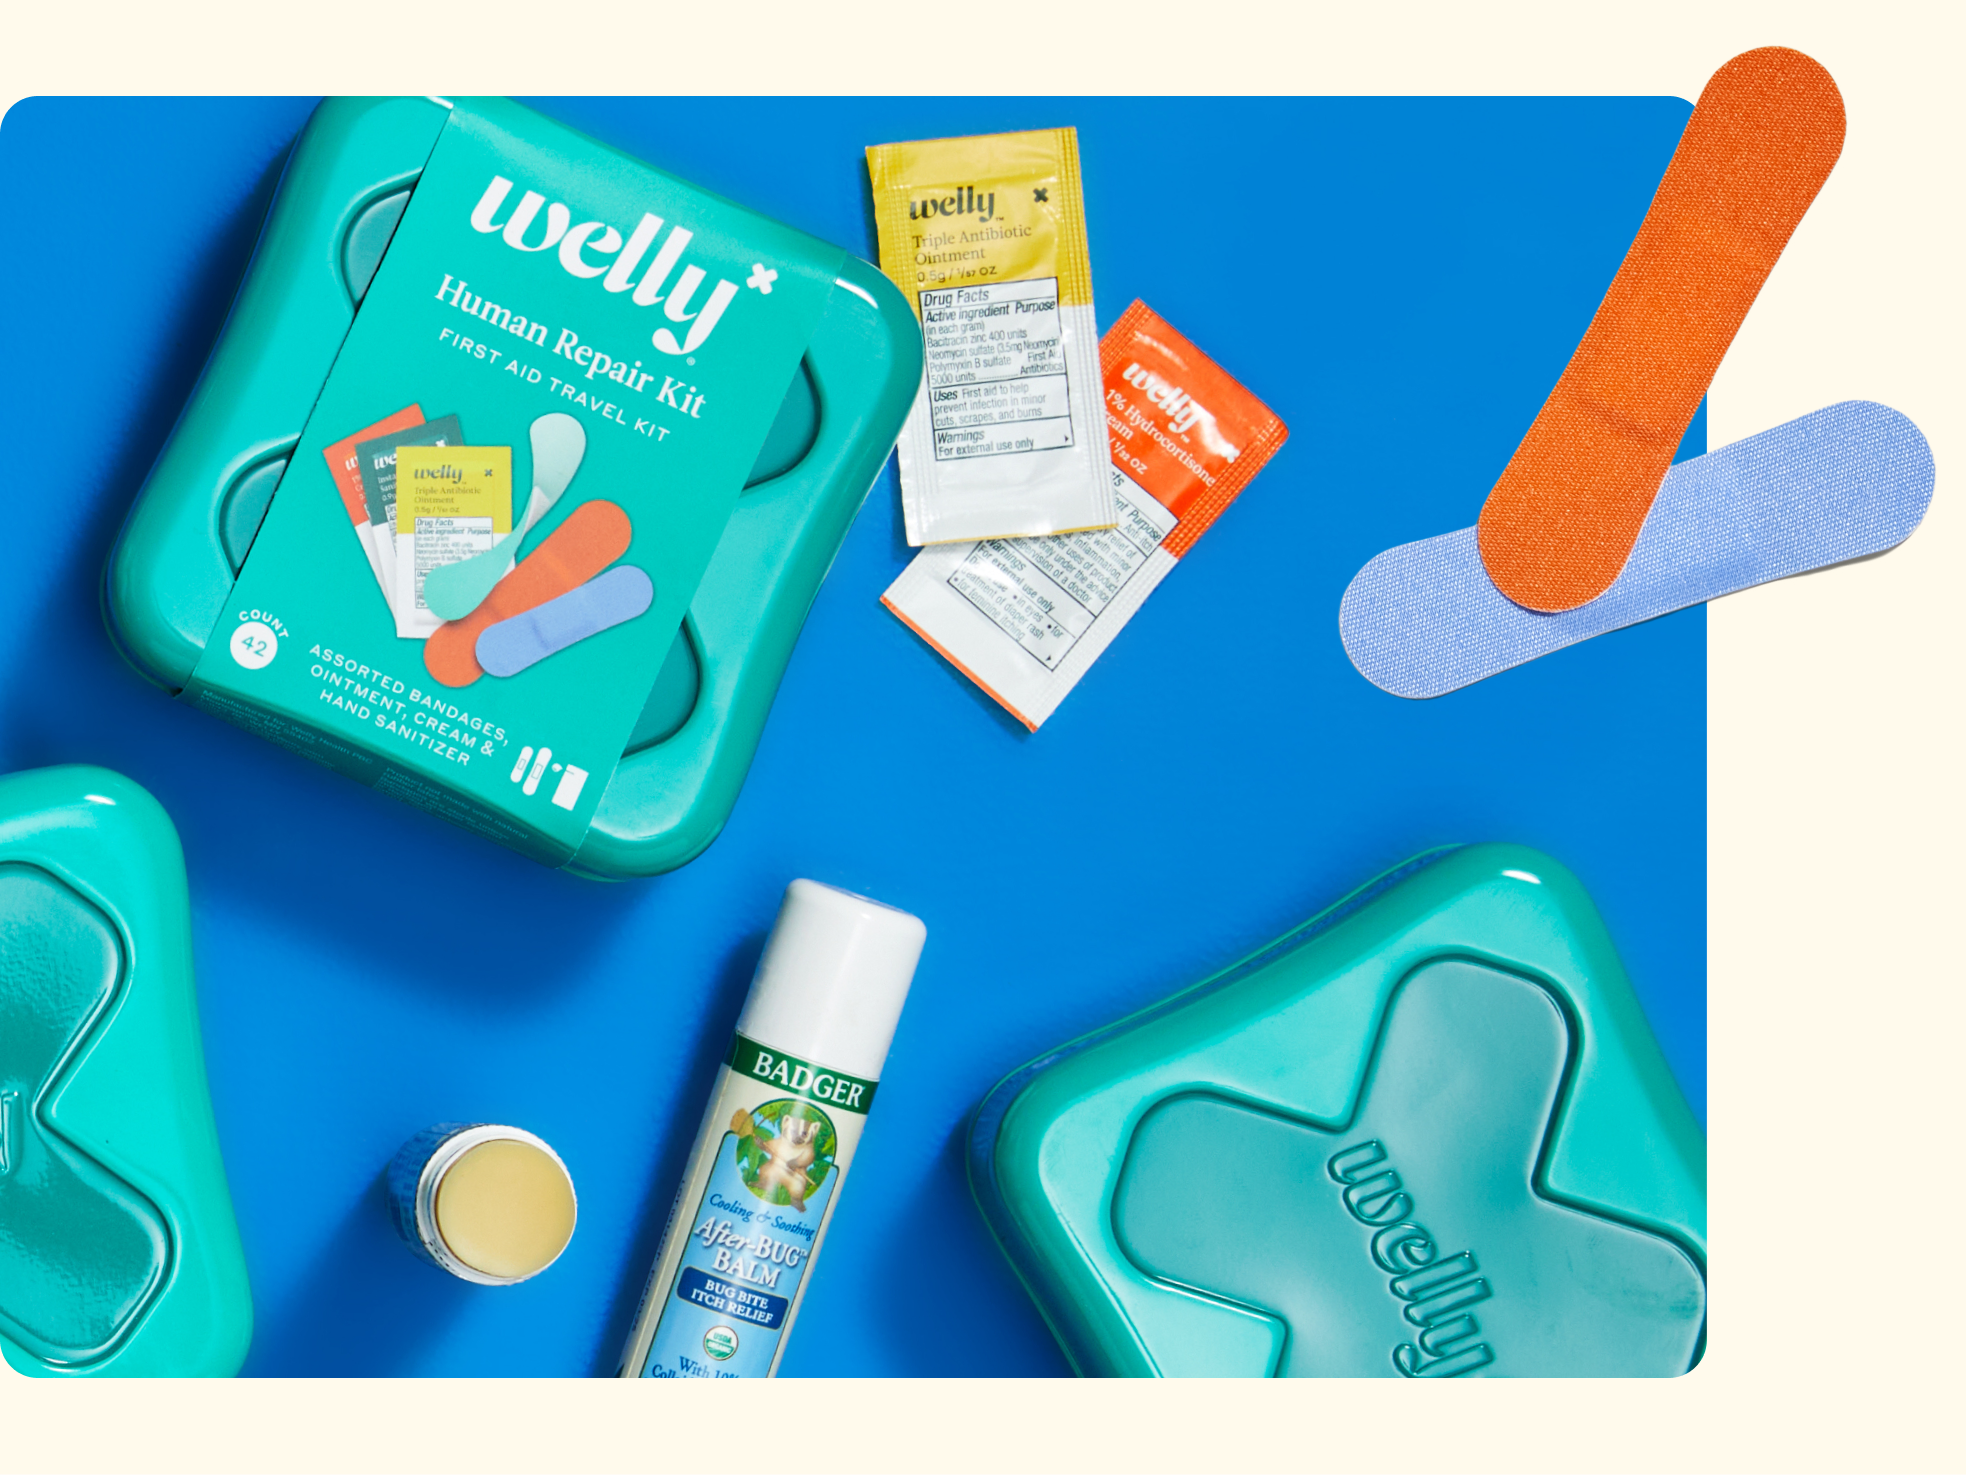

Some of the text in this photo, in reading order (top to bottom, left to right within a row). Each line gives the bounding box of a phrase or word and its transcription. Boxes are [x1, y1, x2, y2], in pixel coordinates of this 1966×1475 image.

[909, 185, 995, 223] welly
[912, 225, 1032, 249] Triple Antibiotic
[470, 175, 739, 355] welly
[914, 247, 985, 266] Ointment
[917, 270, 946, 283] 0.5g
[924, 289, 989, 308] Drug Facts
[925, 301, 1055, 323] Active ingredient Purpose
[927, 328, 1027, 348] Bacitracin zinc 400 units
[938, 323, 958, 334] each
[961, 321, 985, 334] gram)
[434, 274, 705, 418] Human Repair Kit
[929, 346, 966, 360] Neomycin
[969, 344, 995, 357] sulfate
[1027, 351, 1046, 363] First
[930, 356, 1011, 373] Polymyxin B sulfate
[931, 363, 1064, 385] 5000 units Antibiotics
[439, 327, 670, 441] FIRST AID TRAVEL KIT
[933, 382, 1029, 402] Uses First aid to help
[1122, 362, 1200, 433] welly
[934, 393, 1046, 416] prevent infection in minor
[935, 406, 1042, 428] cuts, scrapes, and burns
[938, 429, 985, 444] Warnings
[938, 437, 1034, 457] For external use only
[1106, 389, 1215, 486] 1% Hydrocortisone
[414, 464, 463, 484] welly
[414, 496, 454, 504] Ointment
[415, 486, 481, 496] Triple Antibiotic
[416, 518, 453, 528] Drug Facts
[1123, 523, 1153, 552] Anti-itch
[1127, 509, 1161, 542] Purpose
[986, 540, 1026, 571] Warnings
[1073, 535, 1121, 582] inflammation,
[1093, 538, 1132, 572] with minor
[1107, 531, 1129, 551] relief
[1126, 550, 1137, 559] of
[1009, 536, 1053, 575] supervision
[1052, 569, 1064, 578] of
[1061, 576, 1068, 584] a
[1039, 538, 1056, 558] only
[1054, 553, 1076, 573] under
[1074, 569, 1088, 583] the
[1086, 581, 1109, 602] advice
[1066, 547, 1084, 564] uses
[1082, 561, 1094, 570] of
[1089, 568, 1118, 593] product
[977, 544, 992, 556] For
[992, 558, 1024, 585] external
[1022, 584, 1037, 598] use
[1037, 596, 1055, 616] only
[238, 609, 289, 638] COUNT
[956, 578, 1025, 642] for feminine itching
[995, 596, 1006, 605] of
[1004, 603, 1028, 624] diaper
[1030, 623, 1044, 640] rash
[1016, 597, 1026, 607] in
[1025, 605, 1044, 622] eyes
[1050, 625, 1063, 638] for
[241, 635, 267, 657] 42
[309, 644, 508, 746] ASSORTED BANDAGES,
[203, 689, 271, 719] Manufactured
[291, 725, 316, 740] Welly
[319, 737, 350, 755] Health
[310, 664, 494, 756] OINTMENT, CREAM &
[320, 689, 370, 719] HAND
[375, 714, 470, 765] SANITIZER
[383, 772, 414, 791] rubber
[386, 767, 528, 839] Product not made with natural
[752, 1051, 866, 1107] BADGER
[709, 1193, 816, 1242] Cooling & Soothing
[712, 1247, 781, 1287] BALM
[1327, 1138, 1495, 1378] welly
[691, 1289, 772, 1322] ITCH RELIEF
[705, 1280, 767, 1308] BUG BITE
[713, 1332, 732, 1344] USDA
[680, 1355, 710, 1378] With
